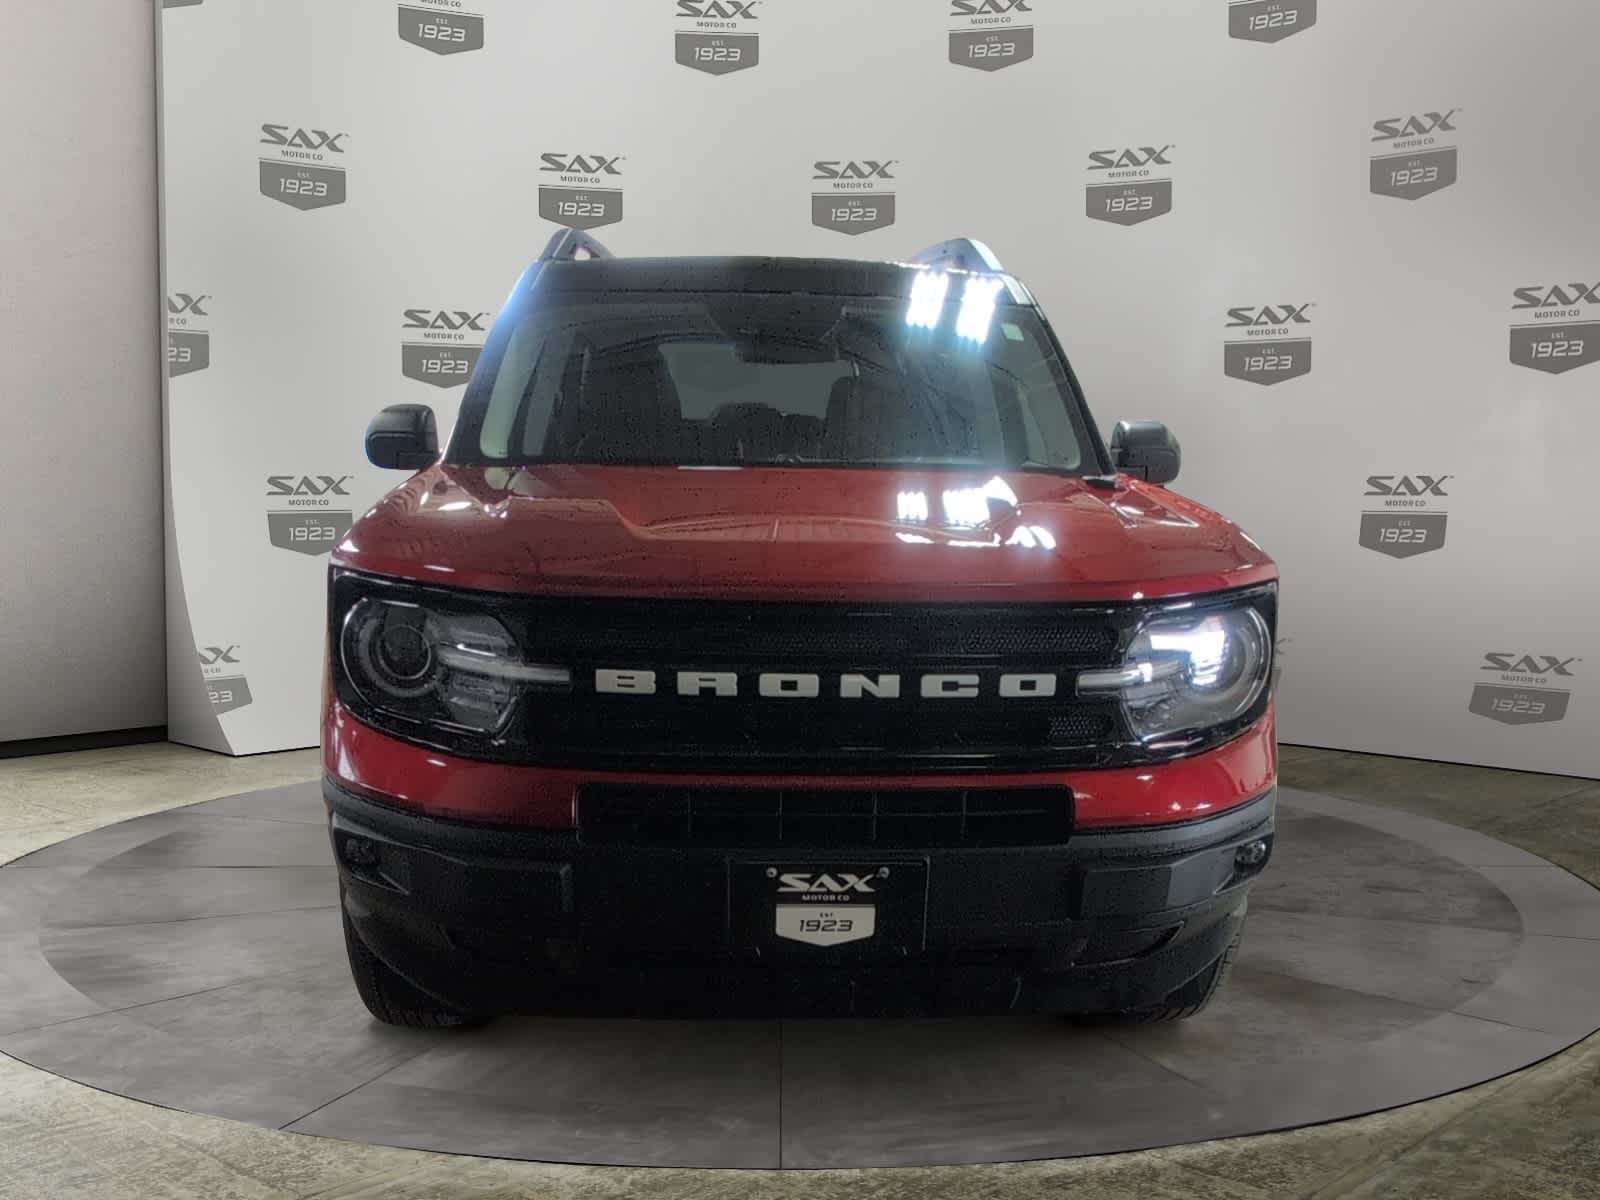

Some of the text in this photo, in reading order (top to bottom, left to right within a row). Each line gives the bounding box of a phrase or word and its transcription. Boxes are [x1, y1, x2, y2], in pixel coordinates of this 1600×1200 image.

[675, 0, 759, 19] SAX
[949, 0, 1033, 16] SAX
[1248, 10, 1298, 31] 1923
[418, 23, 466, 42] 1923
[694, 46, 742, 62] 1923
[968, 43, 1016, 58] 1923
[1370, 108, 1457, 142] SAX
[260, 123, 346, 153] SAX
[1392, 137, 1435, 149] MOTOR CO
[281, 149, 324, 161] MOTOR CO
[538, 152, 623, 175] SAX
[1087, 145, 1172, 170] SAX
[812, 160, 897, 179] SAX
[1137, 169, 1150, 177] CO
[1390, 167, 1439, 187] 1923
[279, 178, 328, 196] 1923
[560, 175, 587, 183] MOTOR
[557, 201, 606, 216] 1923
[1105, 196, 1153, 213] 1923
[831, 208, 878, 221] 1923
[1511, 281, 1600, 309] SAX
[402, 309, 486, 331] SAX
[1224, 304, 1312, 327] SAX
[1534, 309, 1580, 319] MOTOR CO
[424, 332, 453, 340] MOTOR
[167, 347, 192, 362] 23
[1531, 340, 1584, 359] 1923
[421, 359, 469, 374] 1923
[1244, 355, 1293, 371] 1923
[266, 476, 351, 496] SAX
[1363, 476, 1450, 496] SAX
[288, 527, 336, 542] 1923
[1379, 528, 1428, 543] 1923
[1479, 652, 1575, 677] SAX
[595, 669, 1057, 699] BRONCO
[1501, 673, 1531, 683] MOTOR
[208, 690, 233, 704] 23
[1491, 698, 1546, 715] 1923
[777, 873, 876, 893] SAX
[837, 894, 851, 902] CO
[800, 919, 854, 932] 1923
